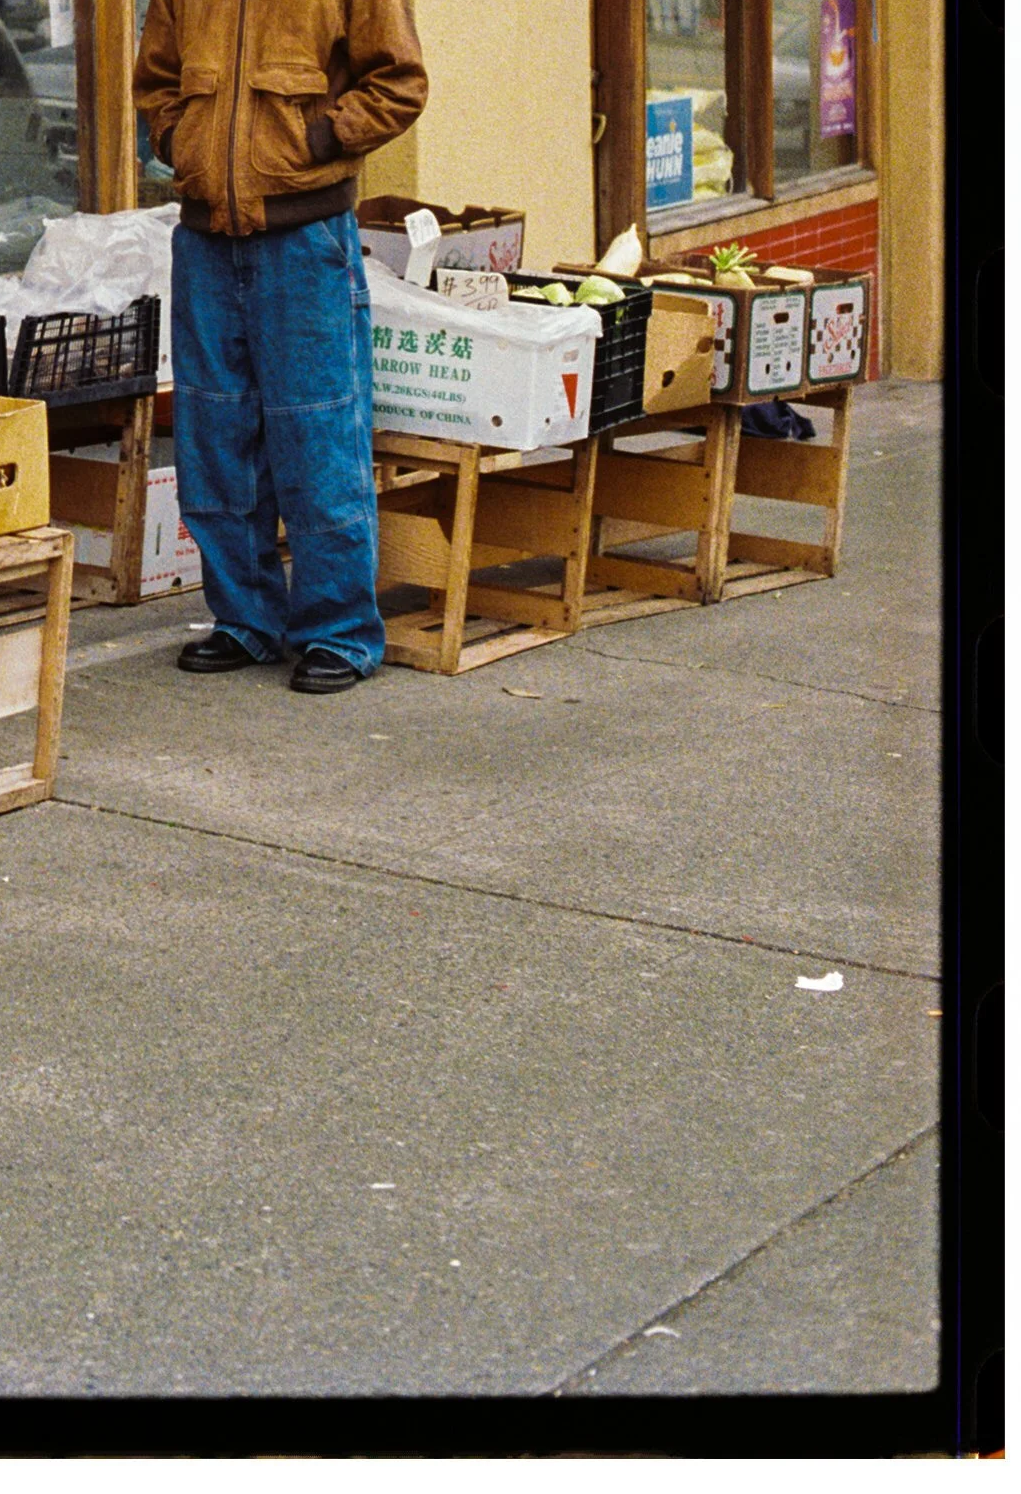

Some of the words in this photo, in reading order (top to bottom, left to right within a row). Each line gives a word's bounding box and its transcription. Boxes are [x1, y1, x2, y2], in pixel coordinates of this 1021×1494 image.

[647, 131, 683, 159] eanie
[647, 153, 683, 182] HUNN
[373, 357, 422, 374] ARROW
[429, 364, 471, 382] HEAD
[373, 402, 415, 417] RODUCE
[419, 409, 434, 420] OF
[436, 412, 471, 426] CHINA
